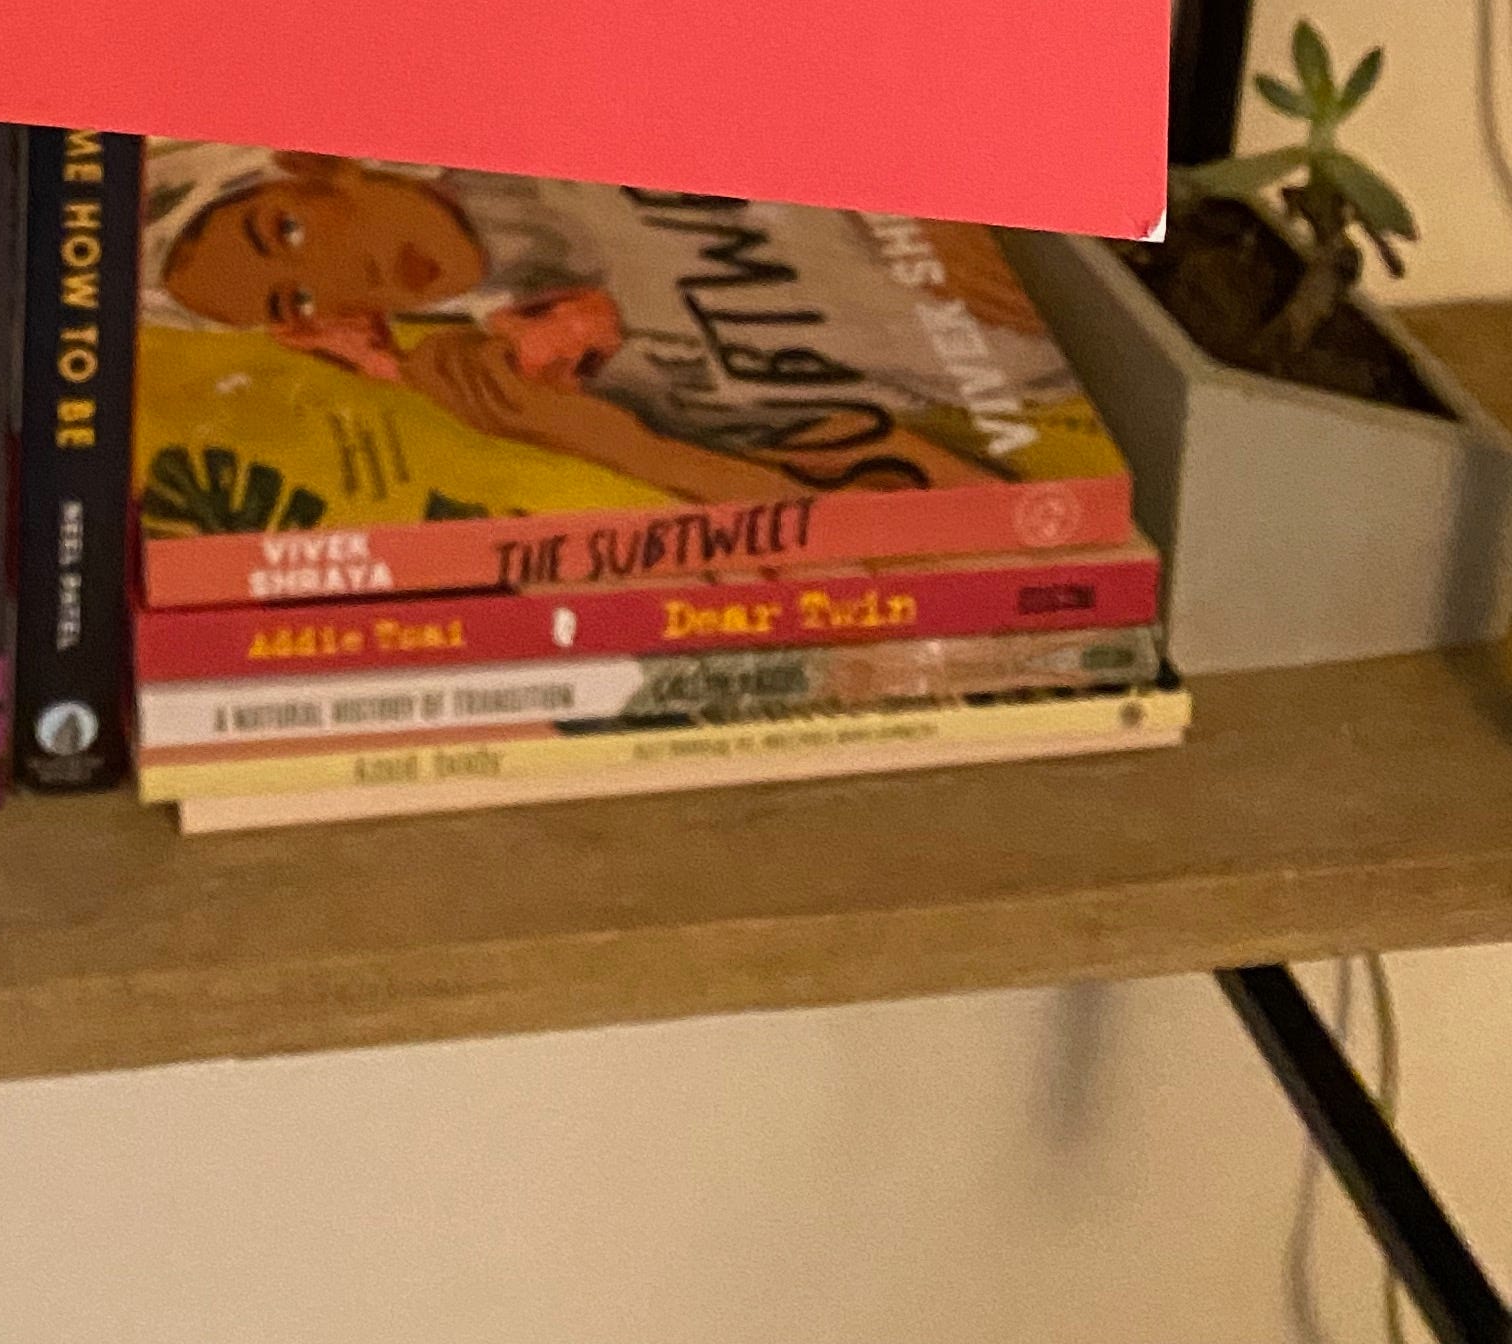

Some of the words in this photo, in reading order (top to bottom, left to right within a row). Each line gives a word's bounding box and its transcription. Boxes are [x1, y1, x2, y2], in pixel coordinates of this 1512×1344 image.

[61, 203, 102, 309] HOW
[58, 328, 100, 383] TO
[56, 399, 98, 450] BE
[497, 533, 566, 587] THE
[589, 497, 817, 580] SUBTWEET
[663, 599, 782, 640] Dear
[799, 590, 918, 628] Twin
